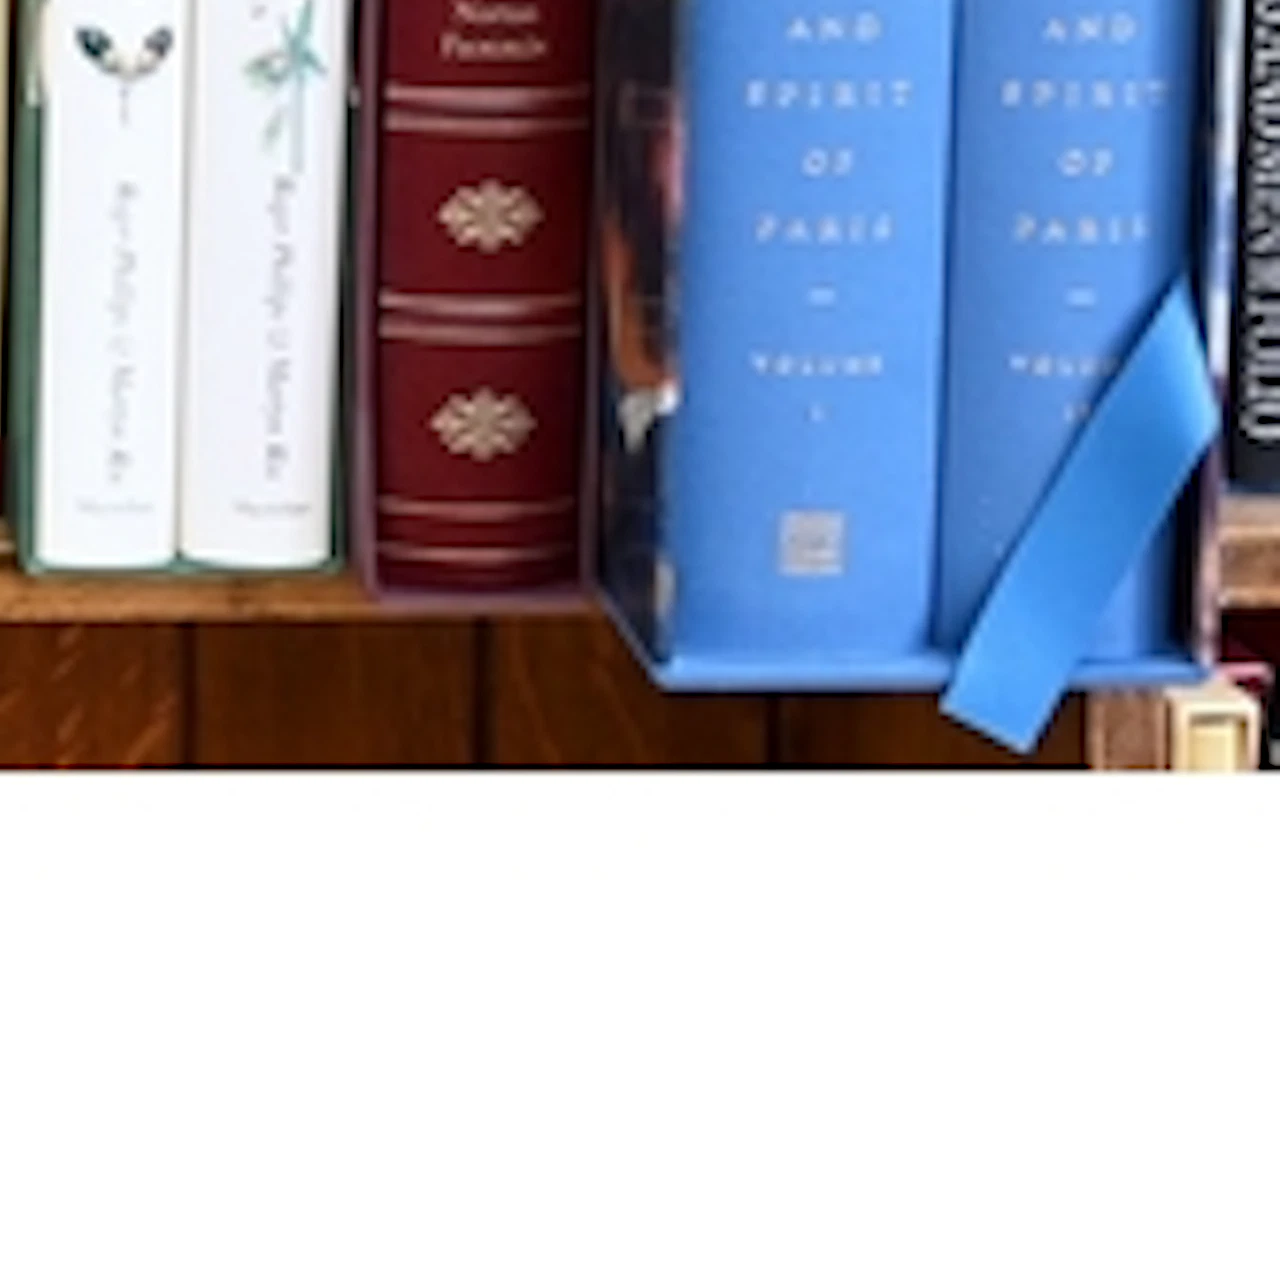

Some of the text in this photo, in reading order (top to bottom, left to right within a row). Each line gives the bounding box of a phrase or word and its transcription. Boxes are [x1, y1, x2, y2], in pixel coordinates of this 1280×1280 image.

[785, 14, 883, 44] AND
[1041, 14, 1140, 44] AND
[744, 80, 915, 110] SPIRIT
[999, 80, 1171, 110] SPIRIT
[800, 149, 855, 177] OF
[1057, 149, 1114, 177] OF
[755, 216, 895, 244] PARIS
[1013, 216, 1150, 244] PARIS
